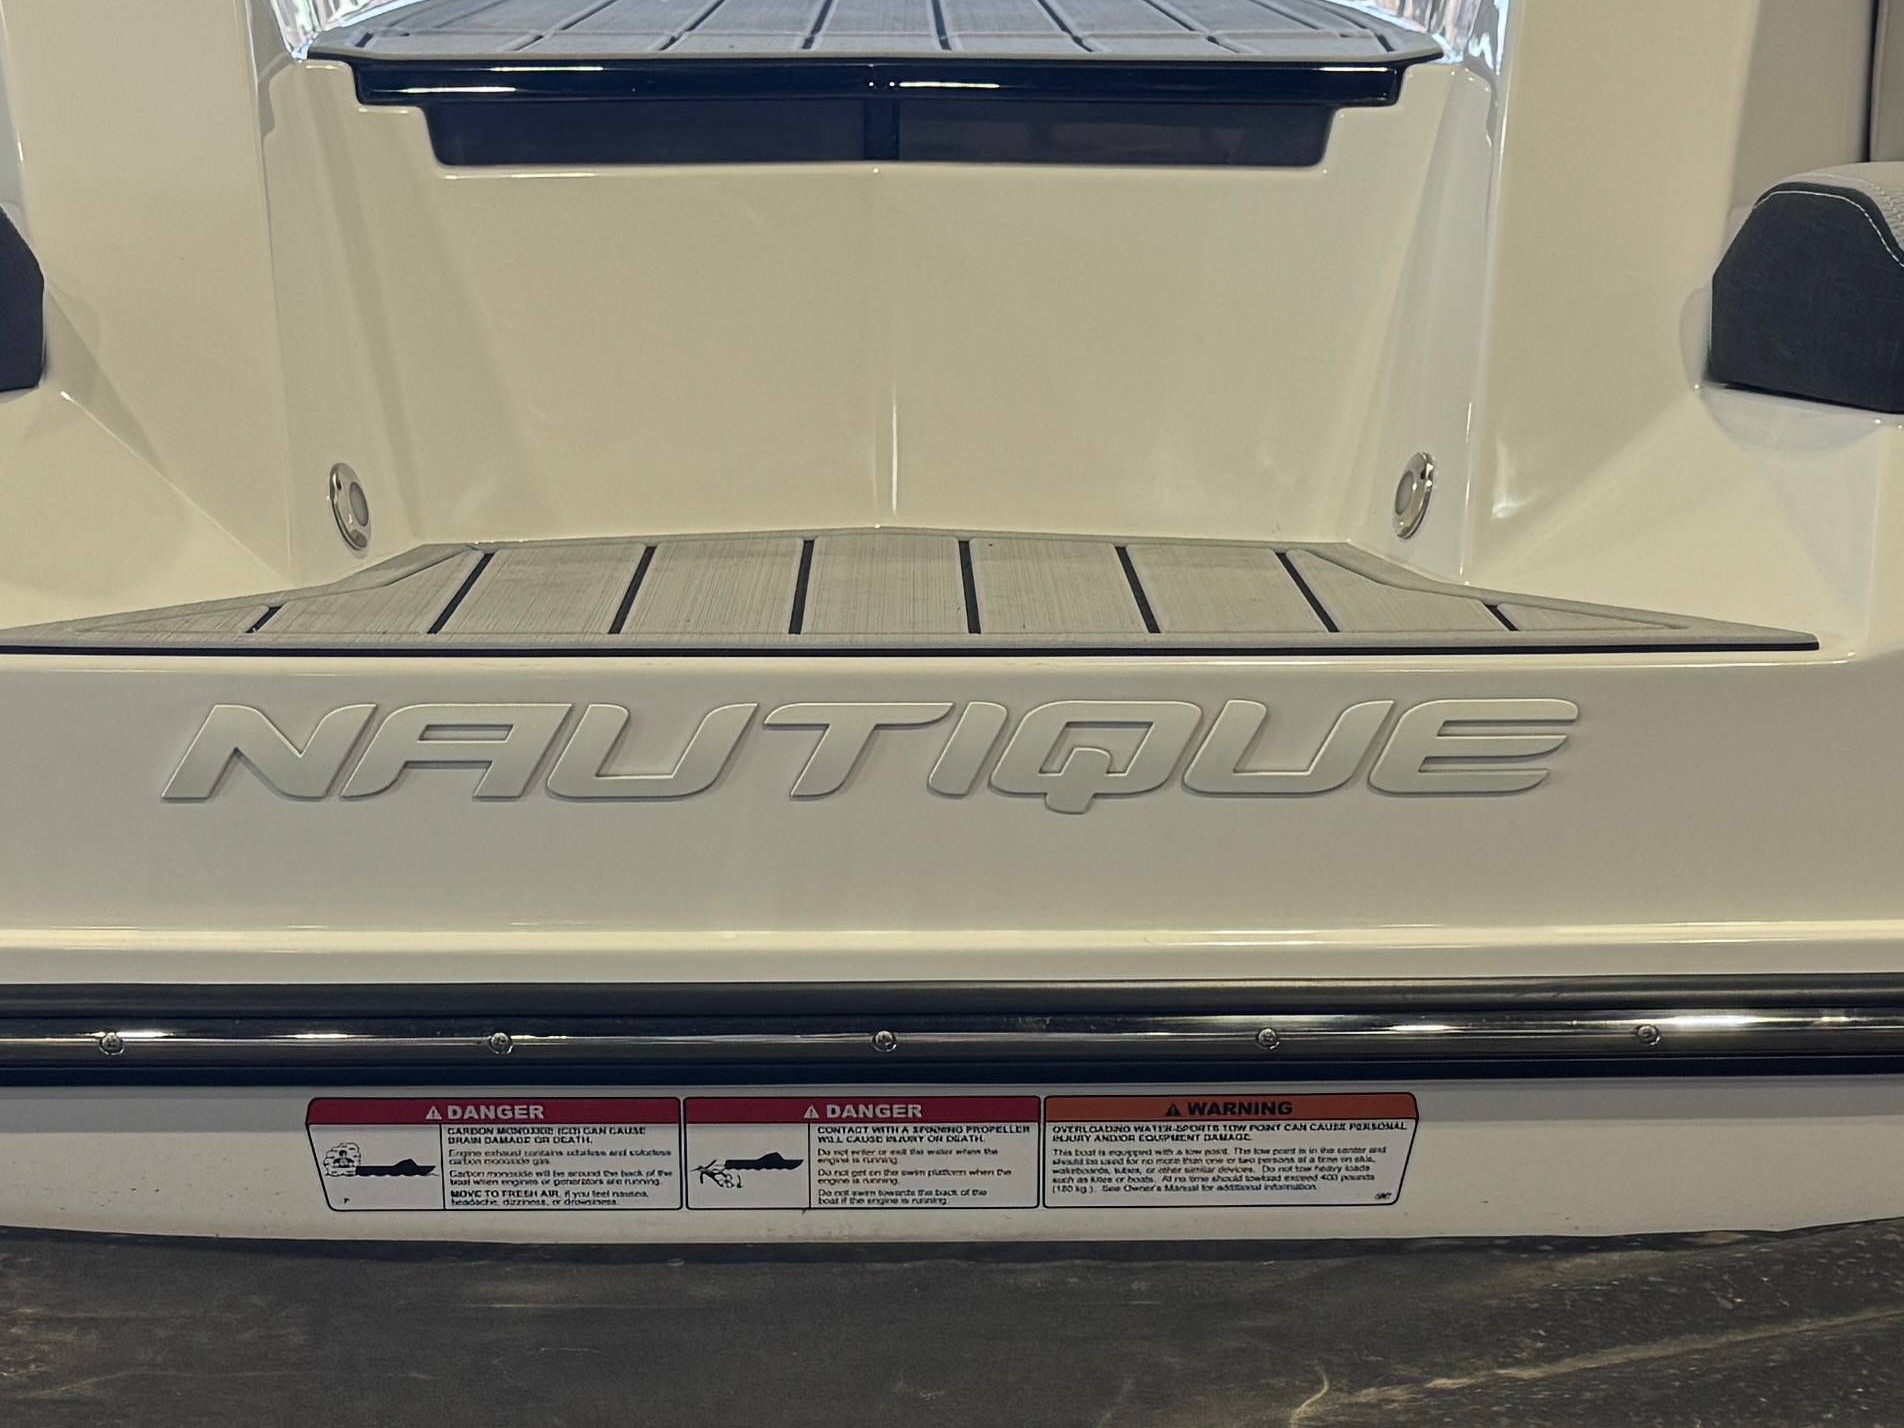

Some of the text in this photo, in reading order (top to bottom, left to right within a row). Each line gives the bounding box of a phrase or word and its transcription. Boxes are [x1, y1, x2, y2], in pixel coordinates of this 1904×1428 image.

[161, 697, 1582, 814] NAUTIQUE
[448, 1105, 544, 1120] DANGER
[827, 1104, 923, 1118] DANGER
[1187, 1101, 1294, 1116] WARNING
